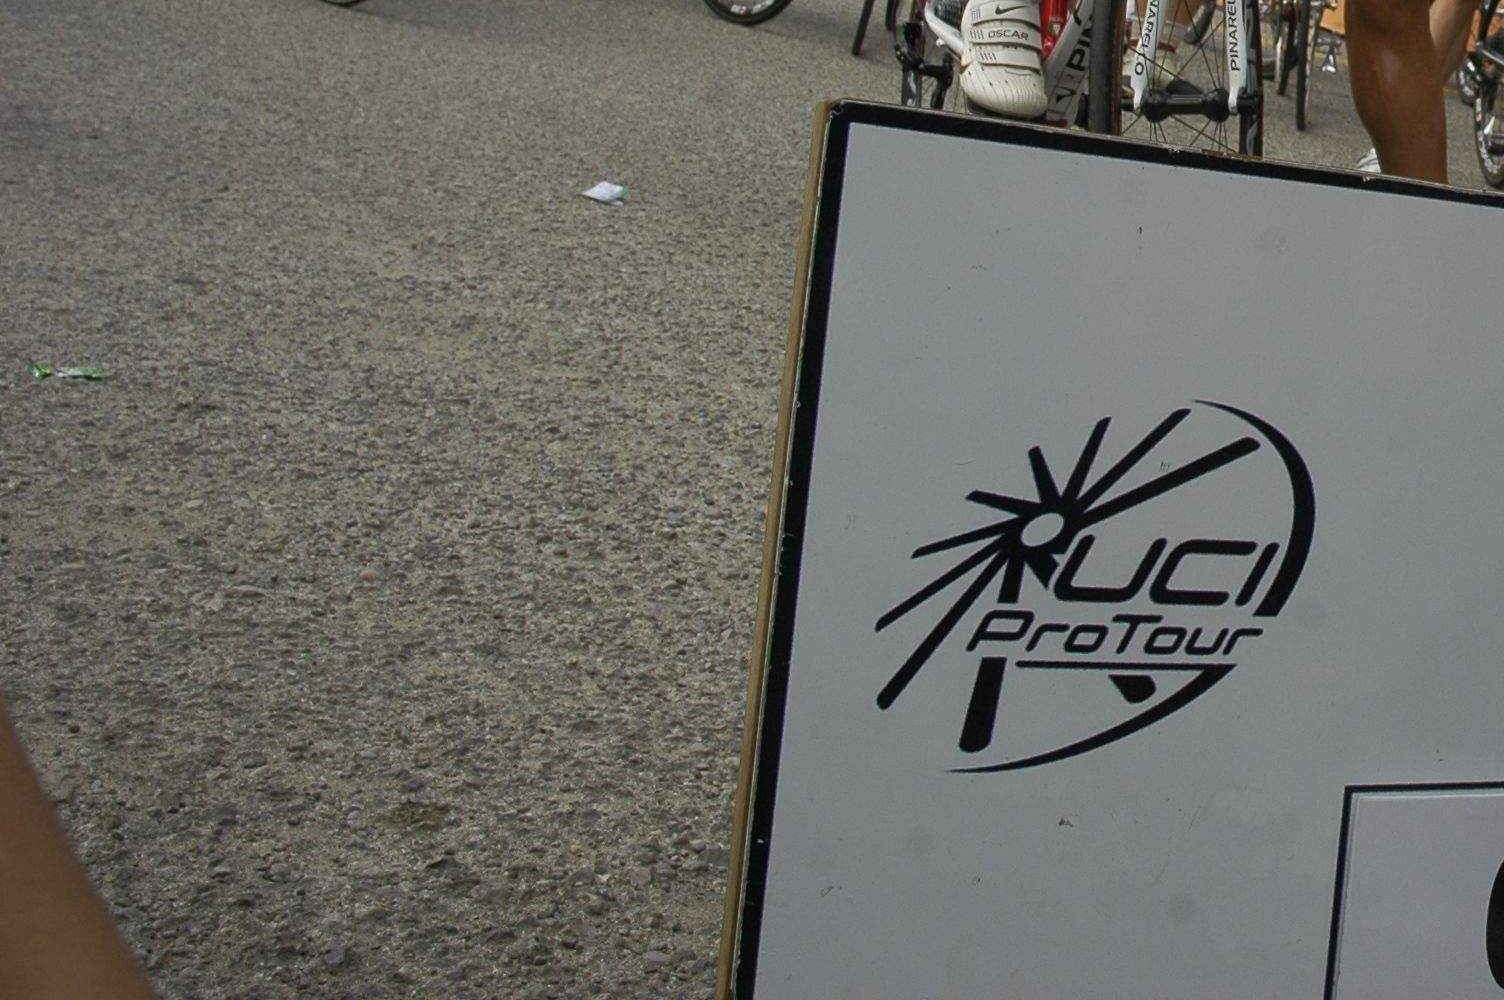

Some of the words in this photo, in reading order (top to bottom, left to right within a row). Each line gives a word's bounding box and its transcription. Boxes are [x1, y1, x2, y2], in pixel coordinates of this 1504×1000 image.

[987, 29, 1029, 41] OSCAR
[1053, 534, 1280, 606] UCI
[966, 610, 1264, 656] ProTour
